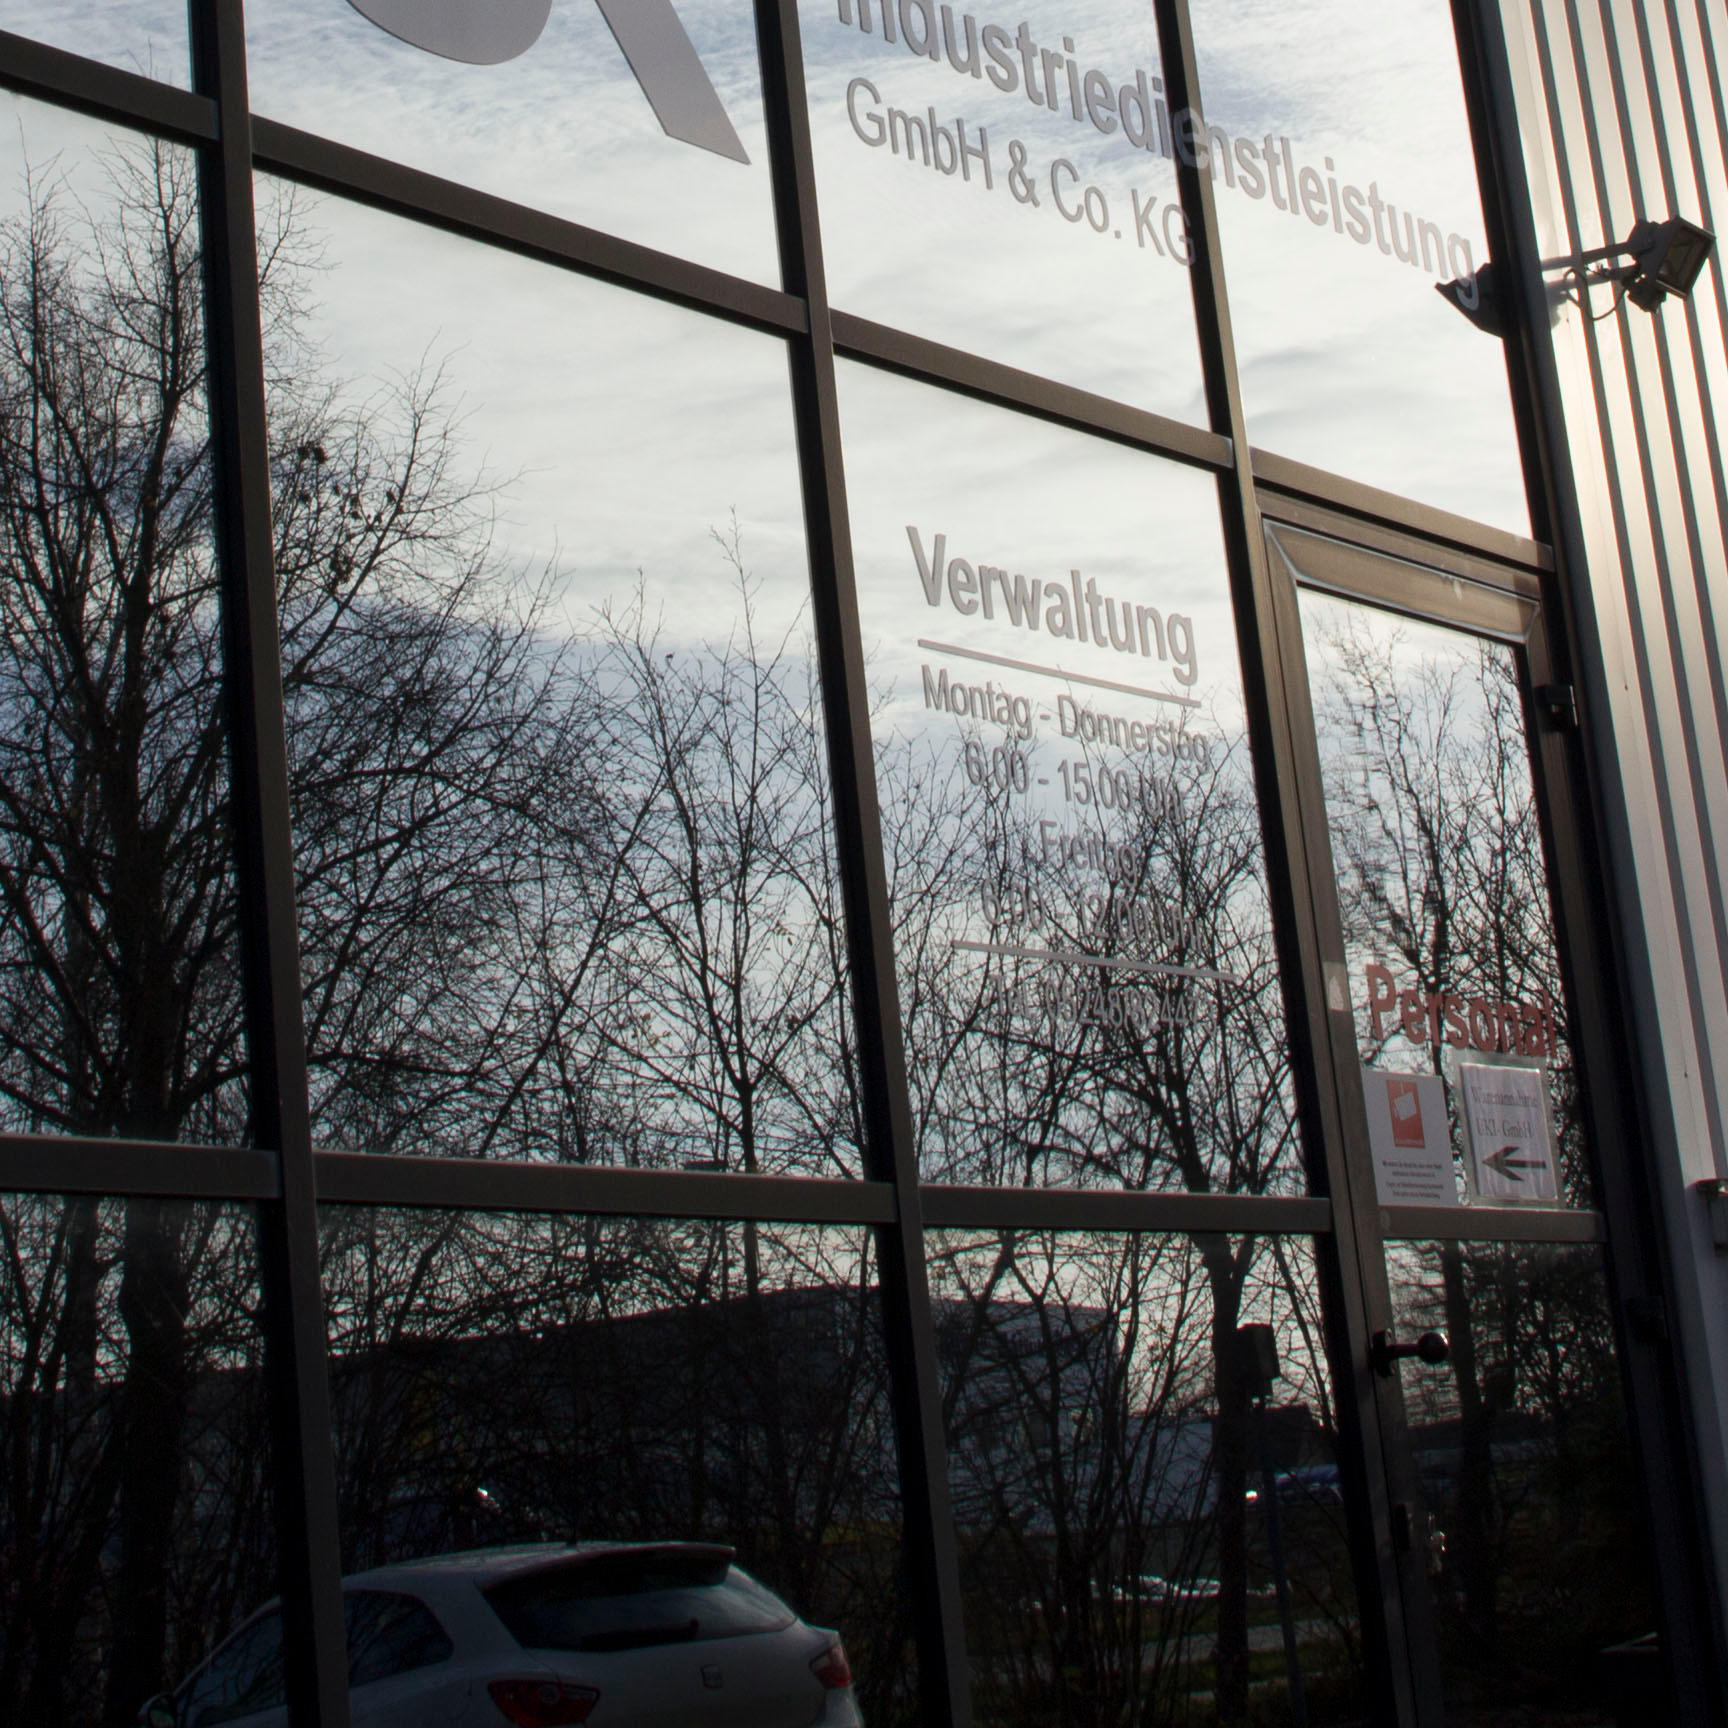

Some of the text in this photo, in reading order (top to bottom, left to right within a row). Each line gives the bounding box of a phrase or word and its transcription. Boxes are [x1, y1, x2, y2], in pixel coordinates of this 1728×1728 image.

[846, 77, 1196, 267] GmbH & Co. KG
[906, 525, 1199, 686] Verwaltung
[922, 664, 1034, 741] Montag
[1057, 694, 1210, 772] Donnerstag
[1039, 820, 1138, 888] Freitag
[1365, 964, 1557, 1058] Personal
